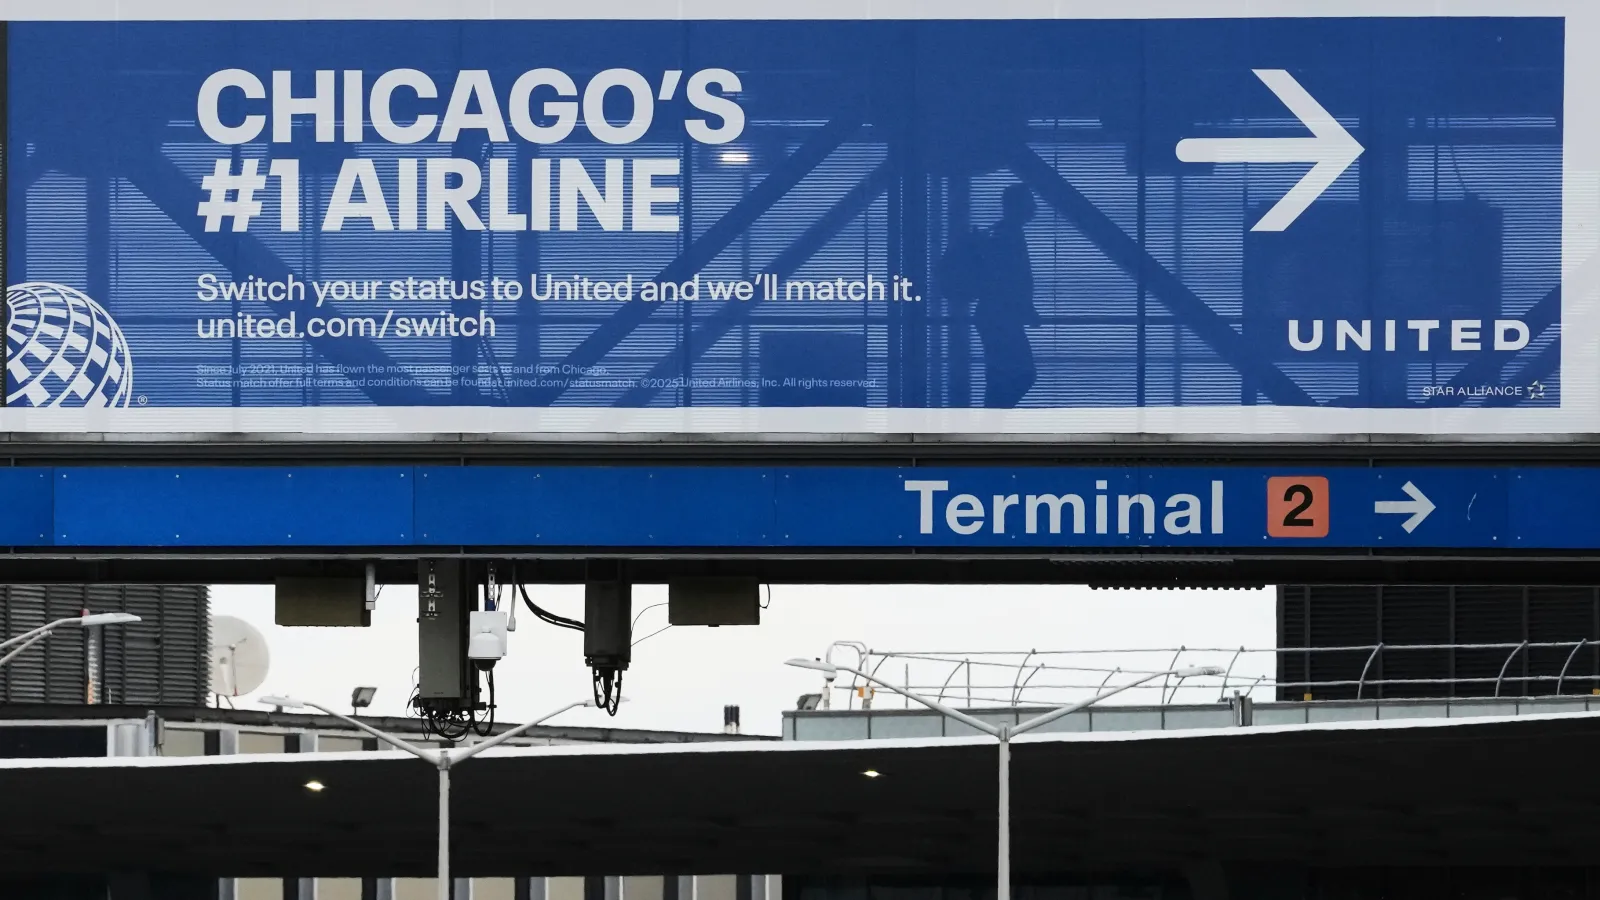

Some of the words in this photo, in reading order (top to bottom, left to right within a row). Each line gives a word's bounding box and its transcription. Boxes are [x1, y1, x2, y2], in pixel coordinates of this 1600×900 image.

[197, 67, 746, 145] CHICAGO’S
[197, 158, 300, 233] #1
[321, 158, 681, 232] AIRLINE
[197, 273, 305, 302] Switch
[312, 279, 383, 307] your
[389, 276, 486, 301] status
[493, 276, 524, 301] to
[531, 273, 633, 302] United
[640, 274, 700, 302] and
[706, 273, 778, 302] we’ll
[786, 274, 886, 302] match
[893, 274, 922, 302] it.
[197, 309, 496, 339] united.com/switch
[1288, 319, 1531, 352] UNITED
[196, 364, 229, 375] Since
[229, 364, 248, 377] July
[250, 364, 278, 376] 2021,
[280, 363, 314, 375] United
[315, 363, 334, 374] has
[336, 363, 365, 374] flown
[367, 364, 385, 374] the
[386, 364, 412, 374] most
[414, 365, 470, 376] passenger
[472, 364, 498, 374] seats
[501, 364, 511, 374] to
[513, 364, 533, 374] and
[535, 363, 560, 374] from
[562, 364, 610, 377] Chicago.
[196, 377, 231, 388] Status
[232, 377, 267, 388] match
[268, 377, 295, 388] offer
[295, 376, 312, 387] full
[313, 377, 343, 387] terms
[345, 376, 366, 387] and
[367, 376, 421, 387] conditions
[421, 379, 444, 387] can
[445, 377, 459, 387] be
[460, 376, 491, 387] found
[681, 377, 716, 388] United
[718, 377, 760, 389] Airlines,
[761, 376, 781, 388] Inc.
[783, 376, 797, 388] All
[798, 376, 827, 390] rights
[829, 377, 880, 388] reserved.
[1422, 385, 1455, 397] STAR
[1457, 385, 1523, 397] ALLIANCE
[904, 480, 1225, 535] Terminal
[1281, 484, 1316, 528] 2
